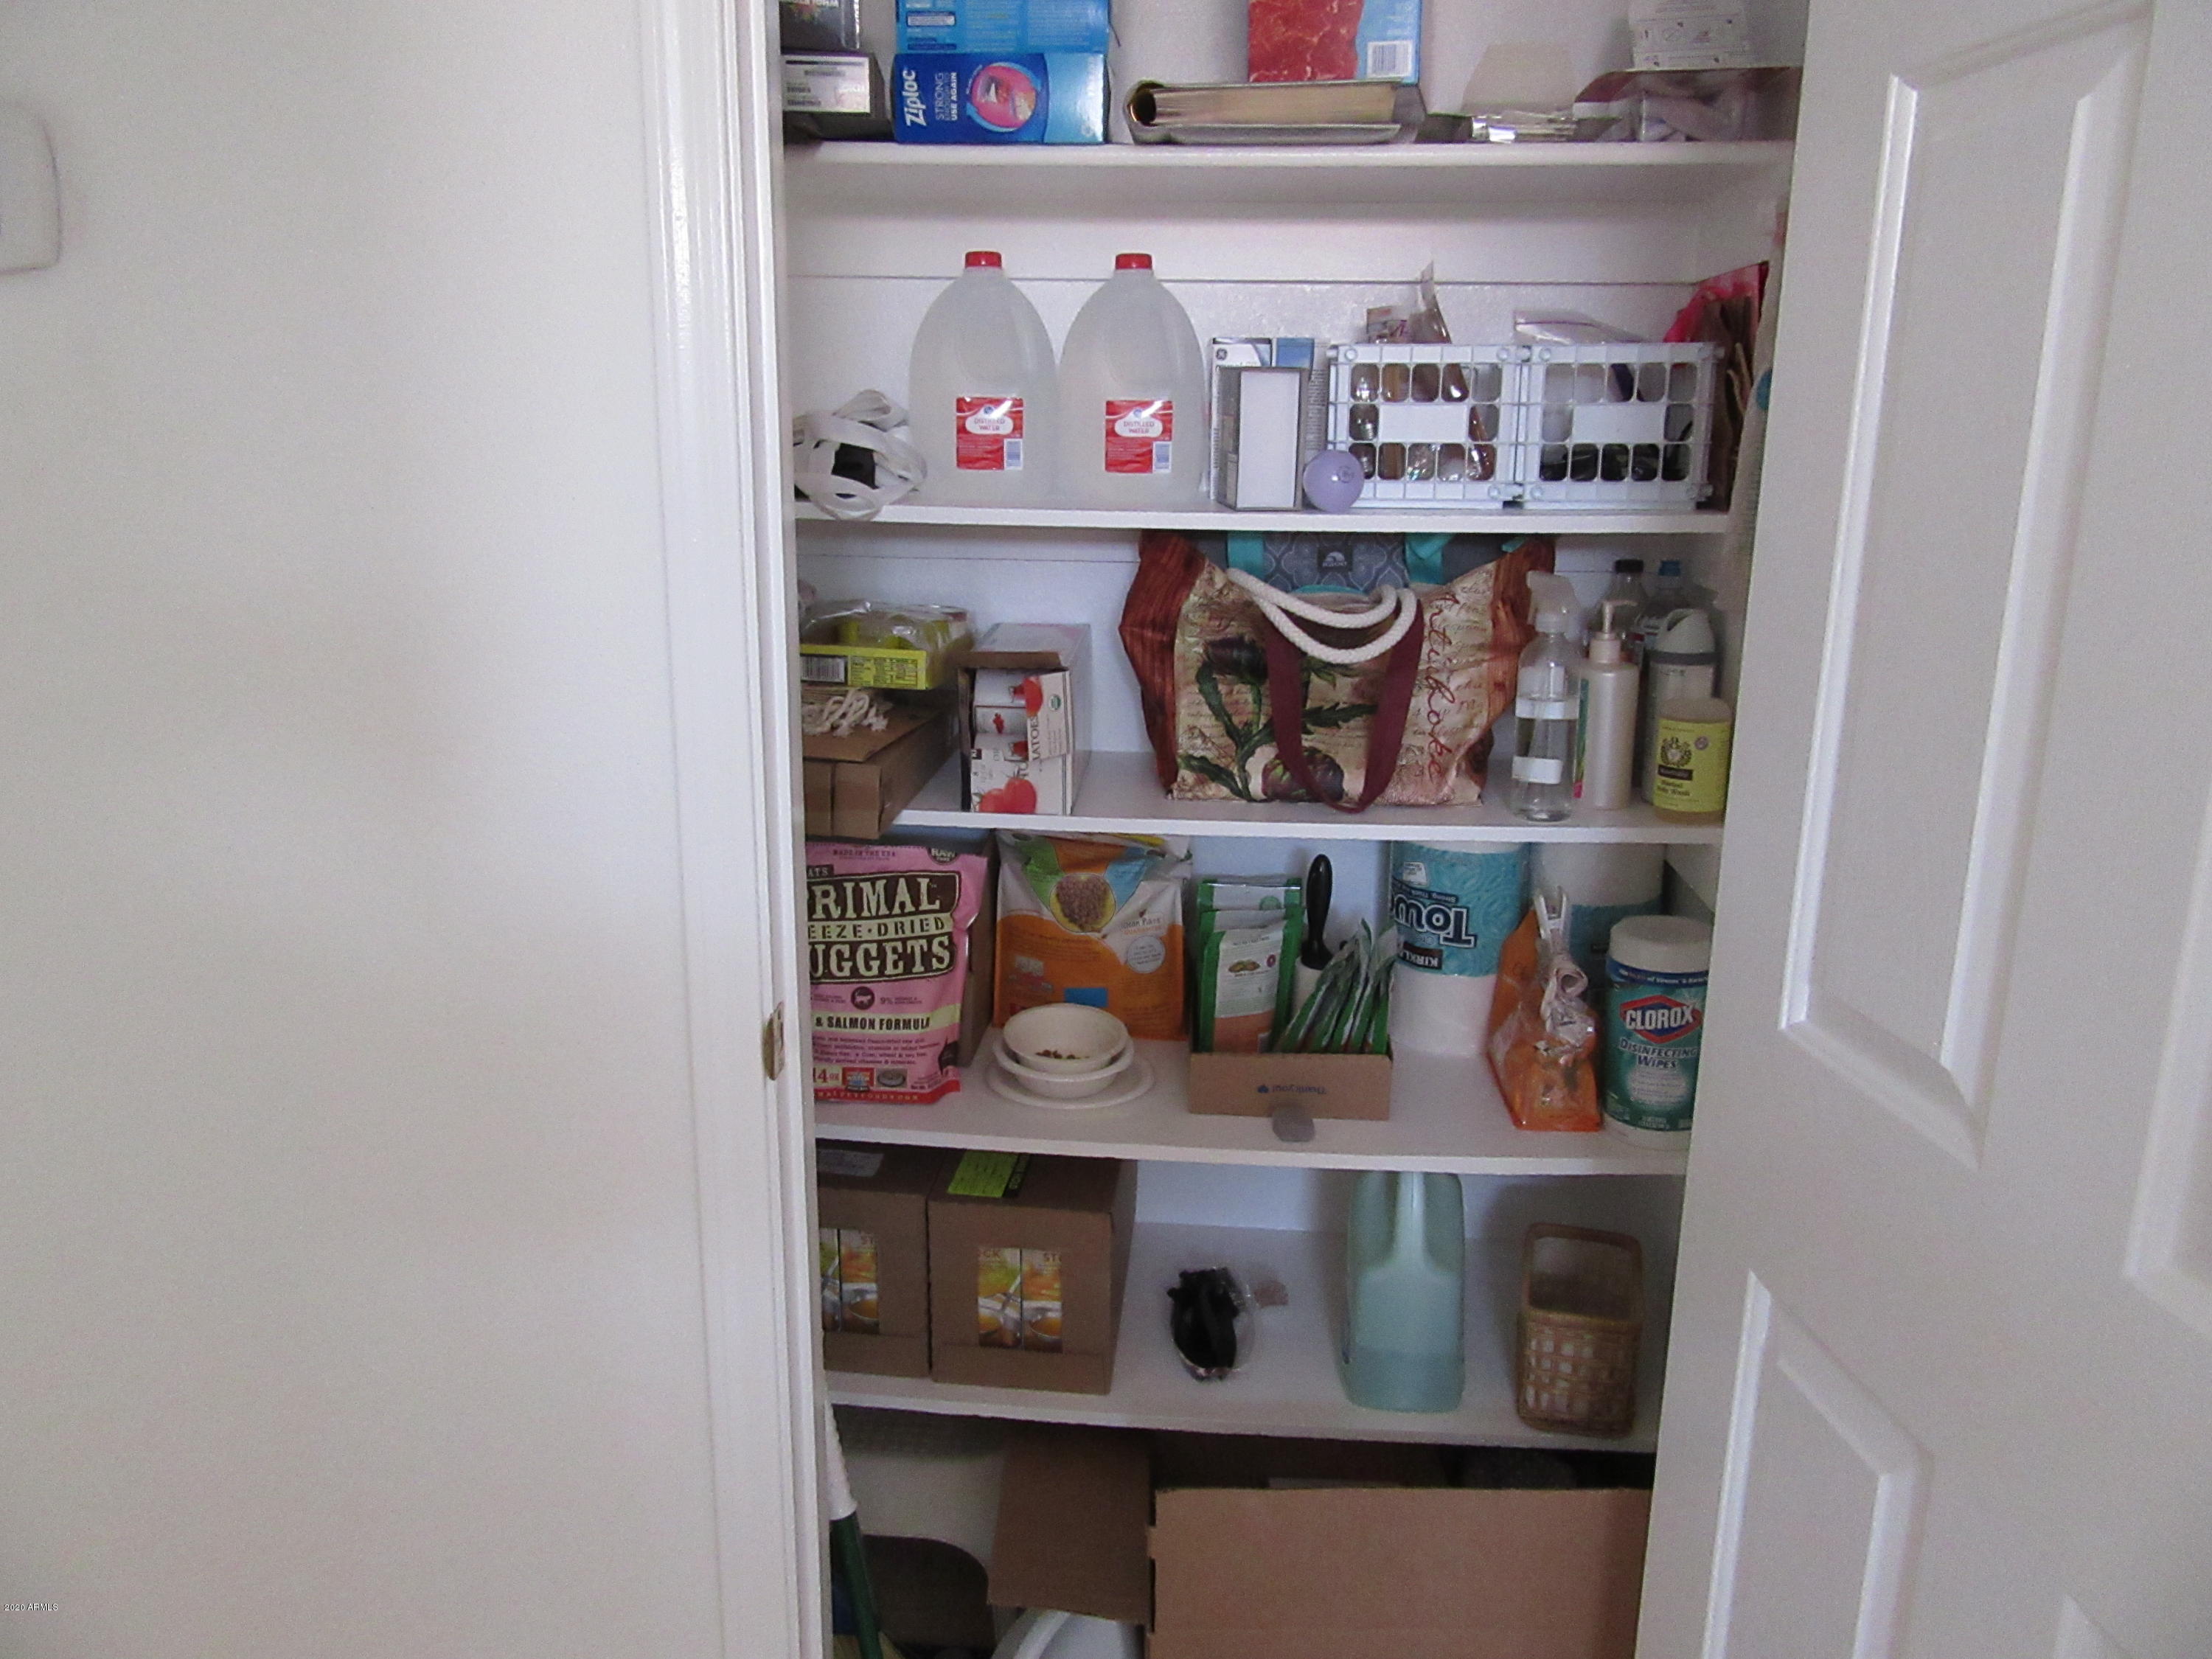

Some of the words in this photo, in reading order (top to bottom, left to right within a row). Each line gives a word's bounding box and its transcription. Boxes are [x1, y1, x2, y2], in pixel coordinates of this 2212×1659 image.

[902, 69, 927, 126] Ziploc
[934, 72, 945, 120] STRONG
[807, 867, 829, 877] ATS
[808, 877, 941, 919] RIMAL
[1394, 894, 1475, 948] Tow
[810, 936, 950, 978] UGGETS
[815, 1016, 823, 1027] &
[827, 1016, 875, 1030] SALMON
[1626, 1004, 1694, 1030] CLOROX
